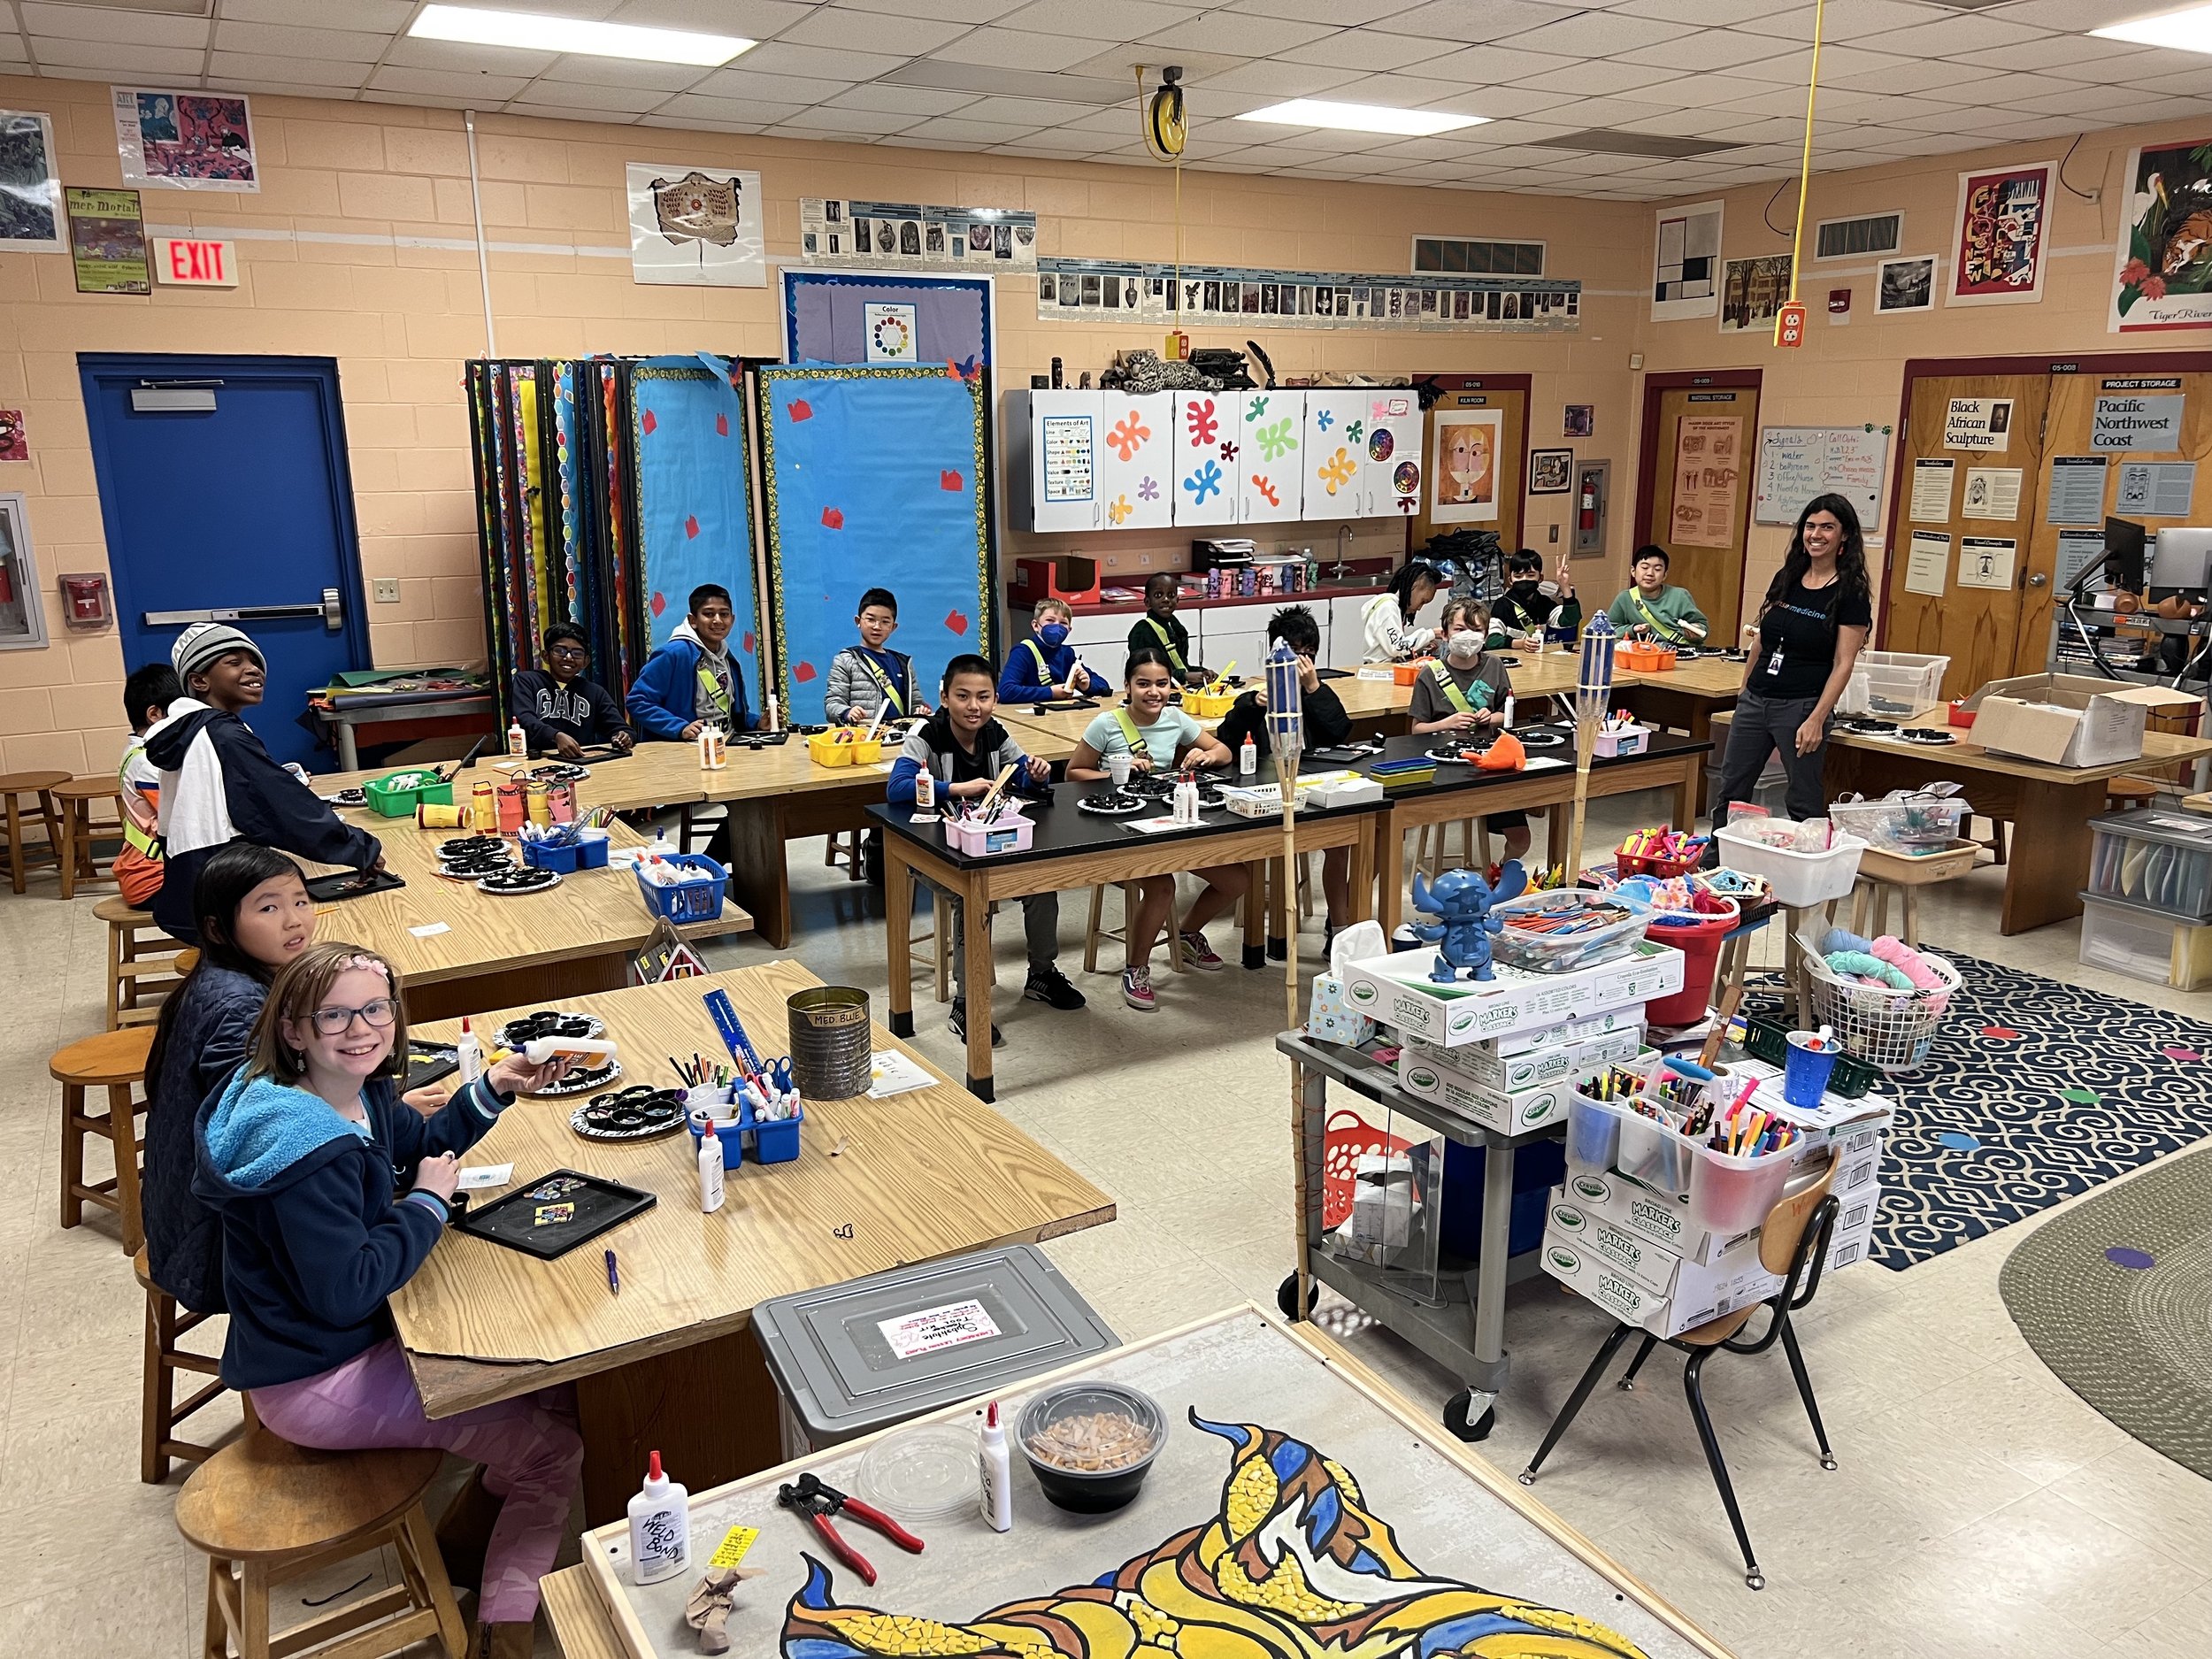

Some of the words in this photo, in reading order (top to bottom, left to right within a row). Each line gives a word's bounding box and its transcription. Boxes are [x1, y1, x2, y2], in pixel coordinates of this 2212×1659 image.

[169, 240, 223, 281] EXIT
[2149, 310, 2177, 322] Tiger
[2140, 380, 2177, 388] STORAGE
[1950, 400, 1980, 413] Black
[2097, 400, 2145, 413] Pacific
[1947, 417, 1985, 429] African
[2095, 416, 2170, 430] Northwest
[1945, 432, 1994, 448] Sculpture
[2093, 433, 2133, 447] Coast
[1781, 451, 1804, 460] water
[535, 687, 591, 726] GAP
[814, 1015, 837, 1025] MED.
[840, 1011, 861, 1023] BLUE
[1394, 998, 1430, 1024] MARKERS
[1479, 1006, 1518, 1025] MARKERS
[1480, 1018, 1516, 1033] CLASSPACK
[1537, 1056, 1569, 1073] MARKERS
[1578, 1179, 1602, 1191] Crayola
[1557, 1208, 1581, 1220] Crayola
[1632, 1201, 1681, 1233] MARKERS
[1631, 1216, 1675, 1240] CLASSPACK
[1597, 1227, 1640, 1262] MARKERS
[1552, 1250, 1575, 1262] Crayola
[1598, 1241, 1638, 1270] CLASSPACK
[1598, 1274, 1641, 1309] MARKERS
[1598, 1288, 1635, 1316] CLASSPACK
[921, 1322, 978, 1340] Substitute
[642, 1518, 675, 1541] WELD
[646, 1537, 679, 1560] BOND
